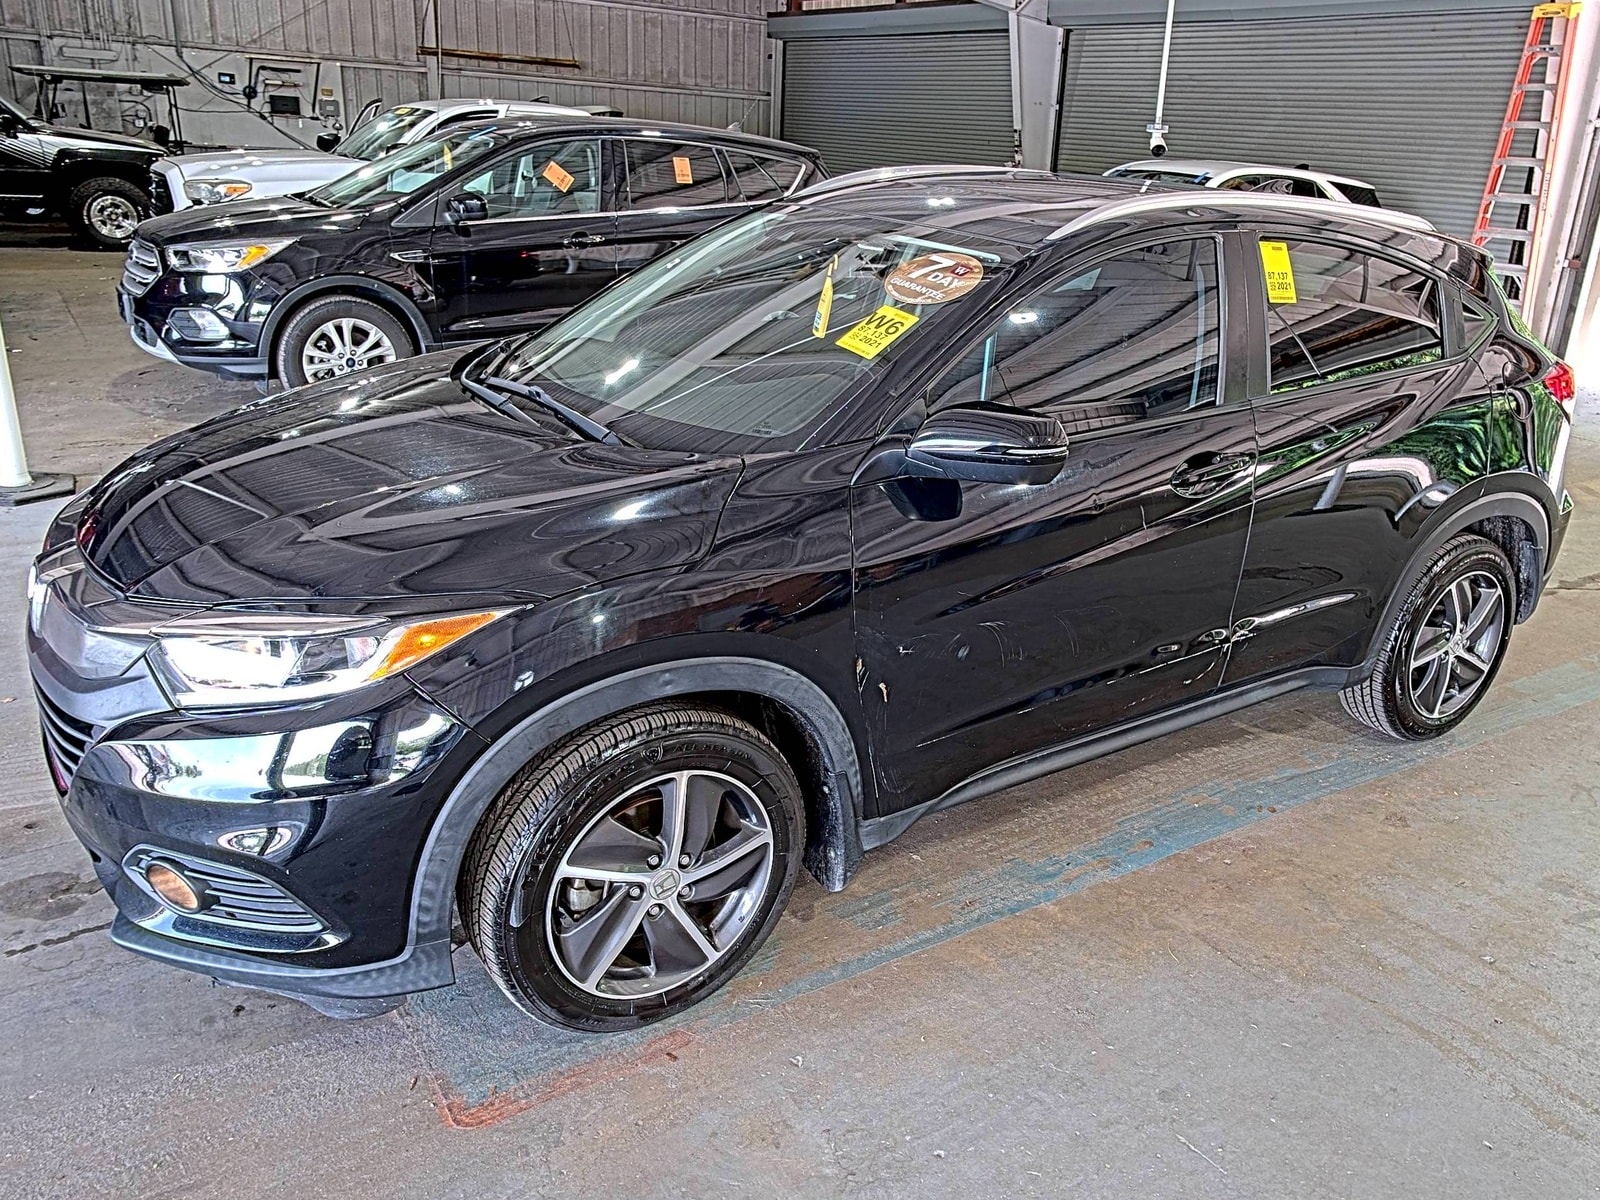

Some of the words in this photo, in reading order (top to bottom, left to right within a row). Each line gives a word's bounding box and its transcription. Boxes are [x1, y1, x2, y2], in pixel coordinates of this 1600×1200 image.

[908, 254, 957, 279] 7
[890, 277, 946, 300] GUARANTEE
[927, 272, 966, 289] DAY
[1277, 282, 1292, 290] 2021
[865, 312, 905, 335] W6
[859, 335, 882, 348] 2021
